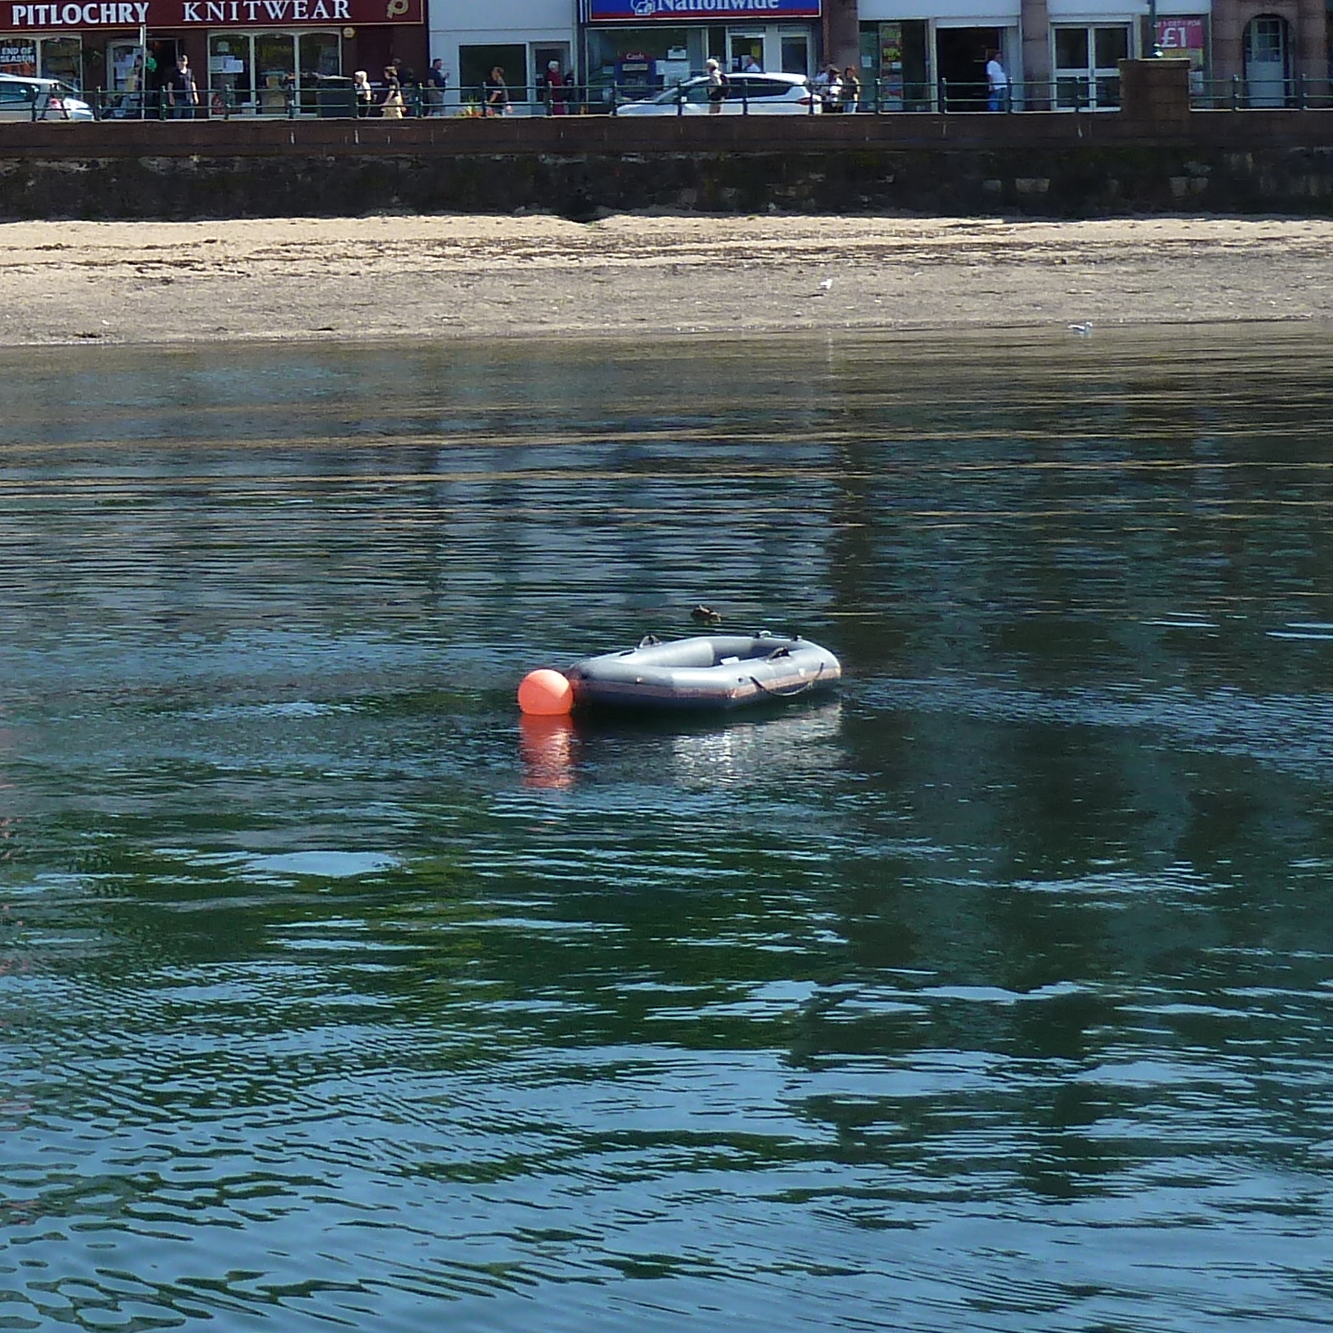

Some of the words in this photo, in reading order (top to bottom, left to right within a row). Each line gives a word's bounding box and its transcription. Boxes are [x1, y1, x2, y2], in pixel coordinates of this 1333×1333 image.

[11, 1, 150, 26] PITLOCHRY
[1161, 27, 1188, 48] £1
[1, 46, 19, 56] END
[20, 45, 34, 55] OF
[0, 54, 36, 64] SEASON
